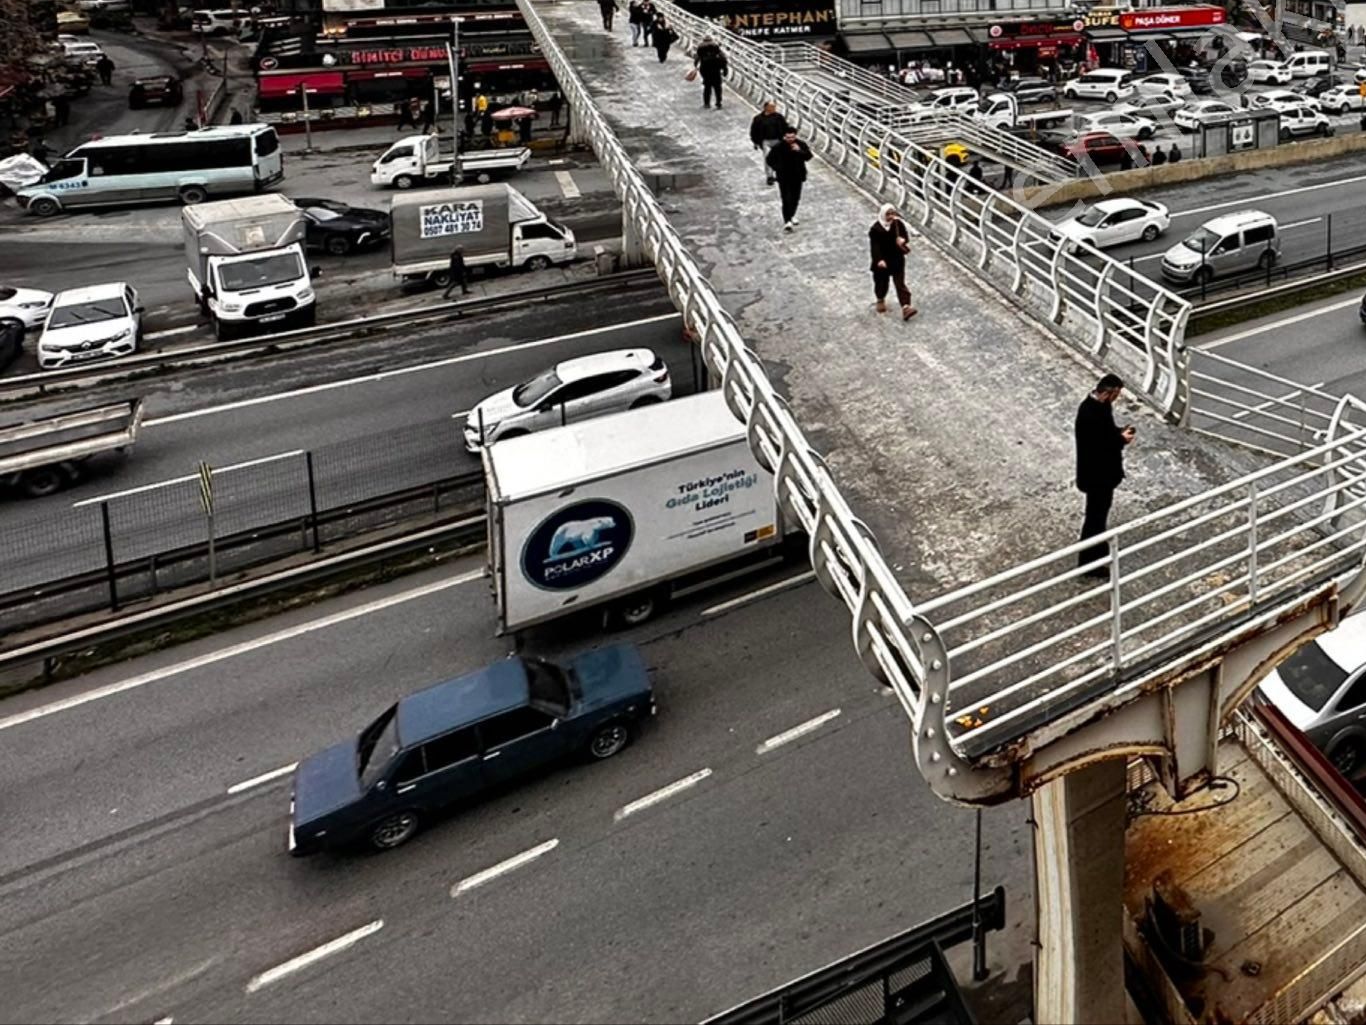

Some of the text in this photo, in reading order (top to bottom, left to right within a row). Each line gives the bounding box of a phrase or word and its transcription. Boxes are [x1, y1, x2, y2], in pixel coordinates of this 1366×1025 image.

[423, 202, 480, 216] KARA
[678, 469, 746, 494] Türkiye'nin
[665, 493, 699, 510] Gıda
[695, 494, 730, 512] Lideri
